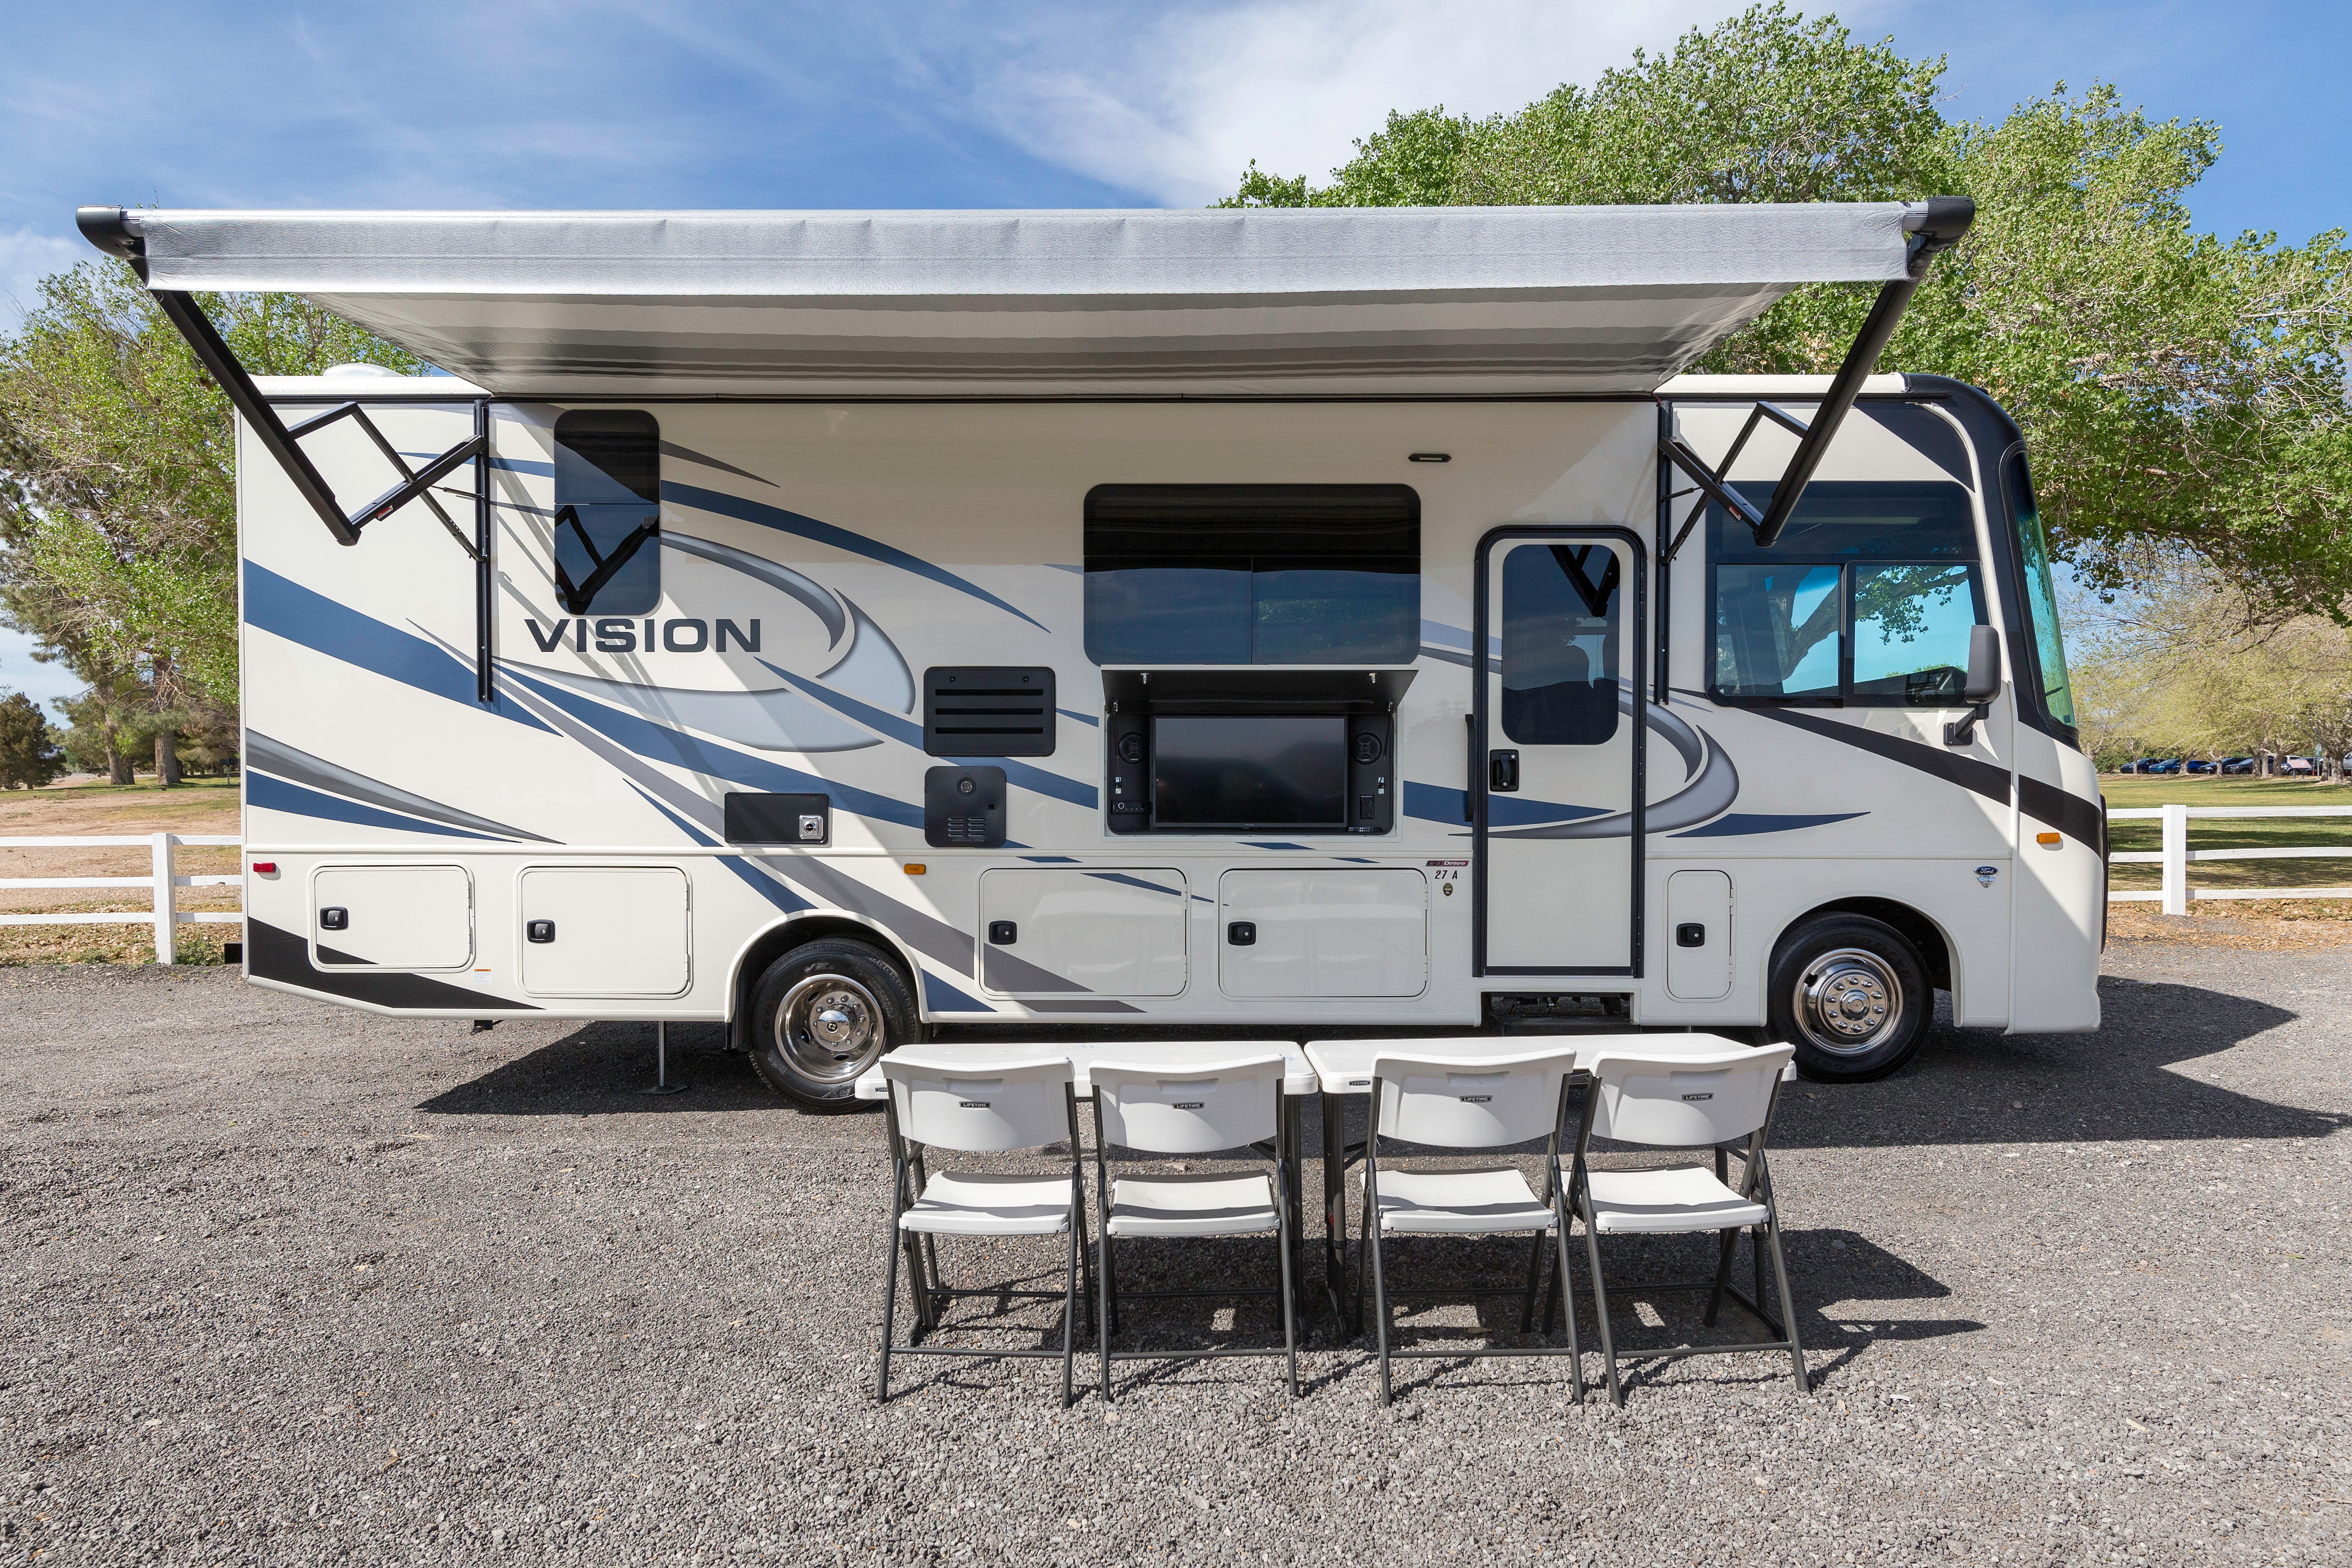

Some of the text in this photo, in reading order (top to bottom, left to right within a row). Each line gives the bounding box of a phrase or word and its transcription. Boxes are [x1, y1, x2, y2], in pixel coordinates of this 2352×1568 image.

[524, 619, 760, 652] VISION
[1435, 870, 1458, 879] 27 A
